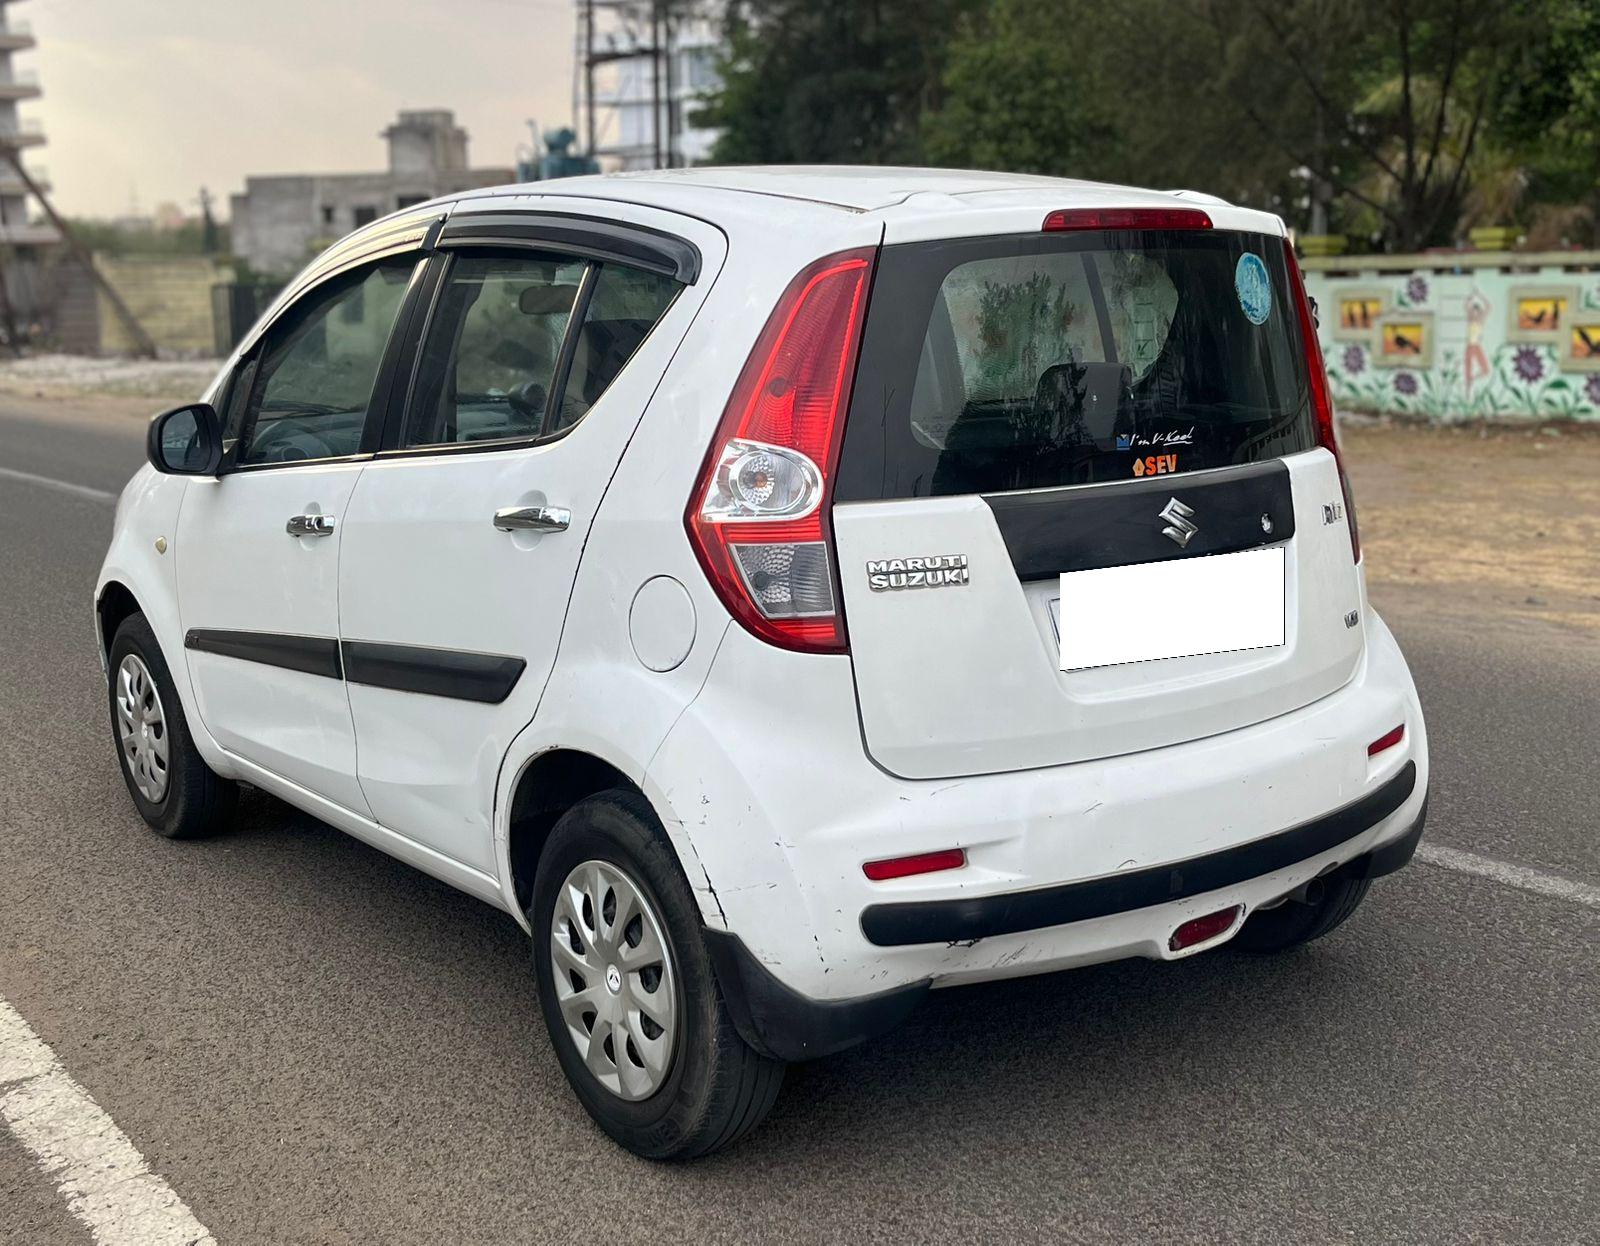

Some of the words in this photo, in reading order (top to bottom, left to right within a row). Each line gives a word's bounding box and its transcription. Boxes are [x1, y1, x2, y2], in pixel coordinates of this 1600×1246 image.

[1145, 454, 1177, 476] SEV
[867, 554, 968, 574] MARUTI
[869, 568, 969, 591] SUZUKI
